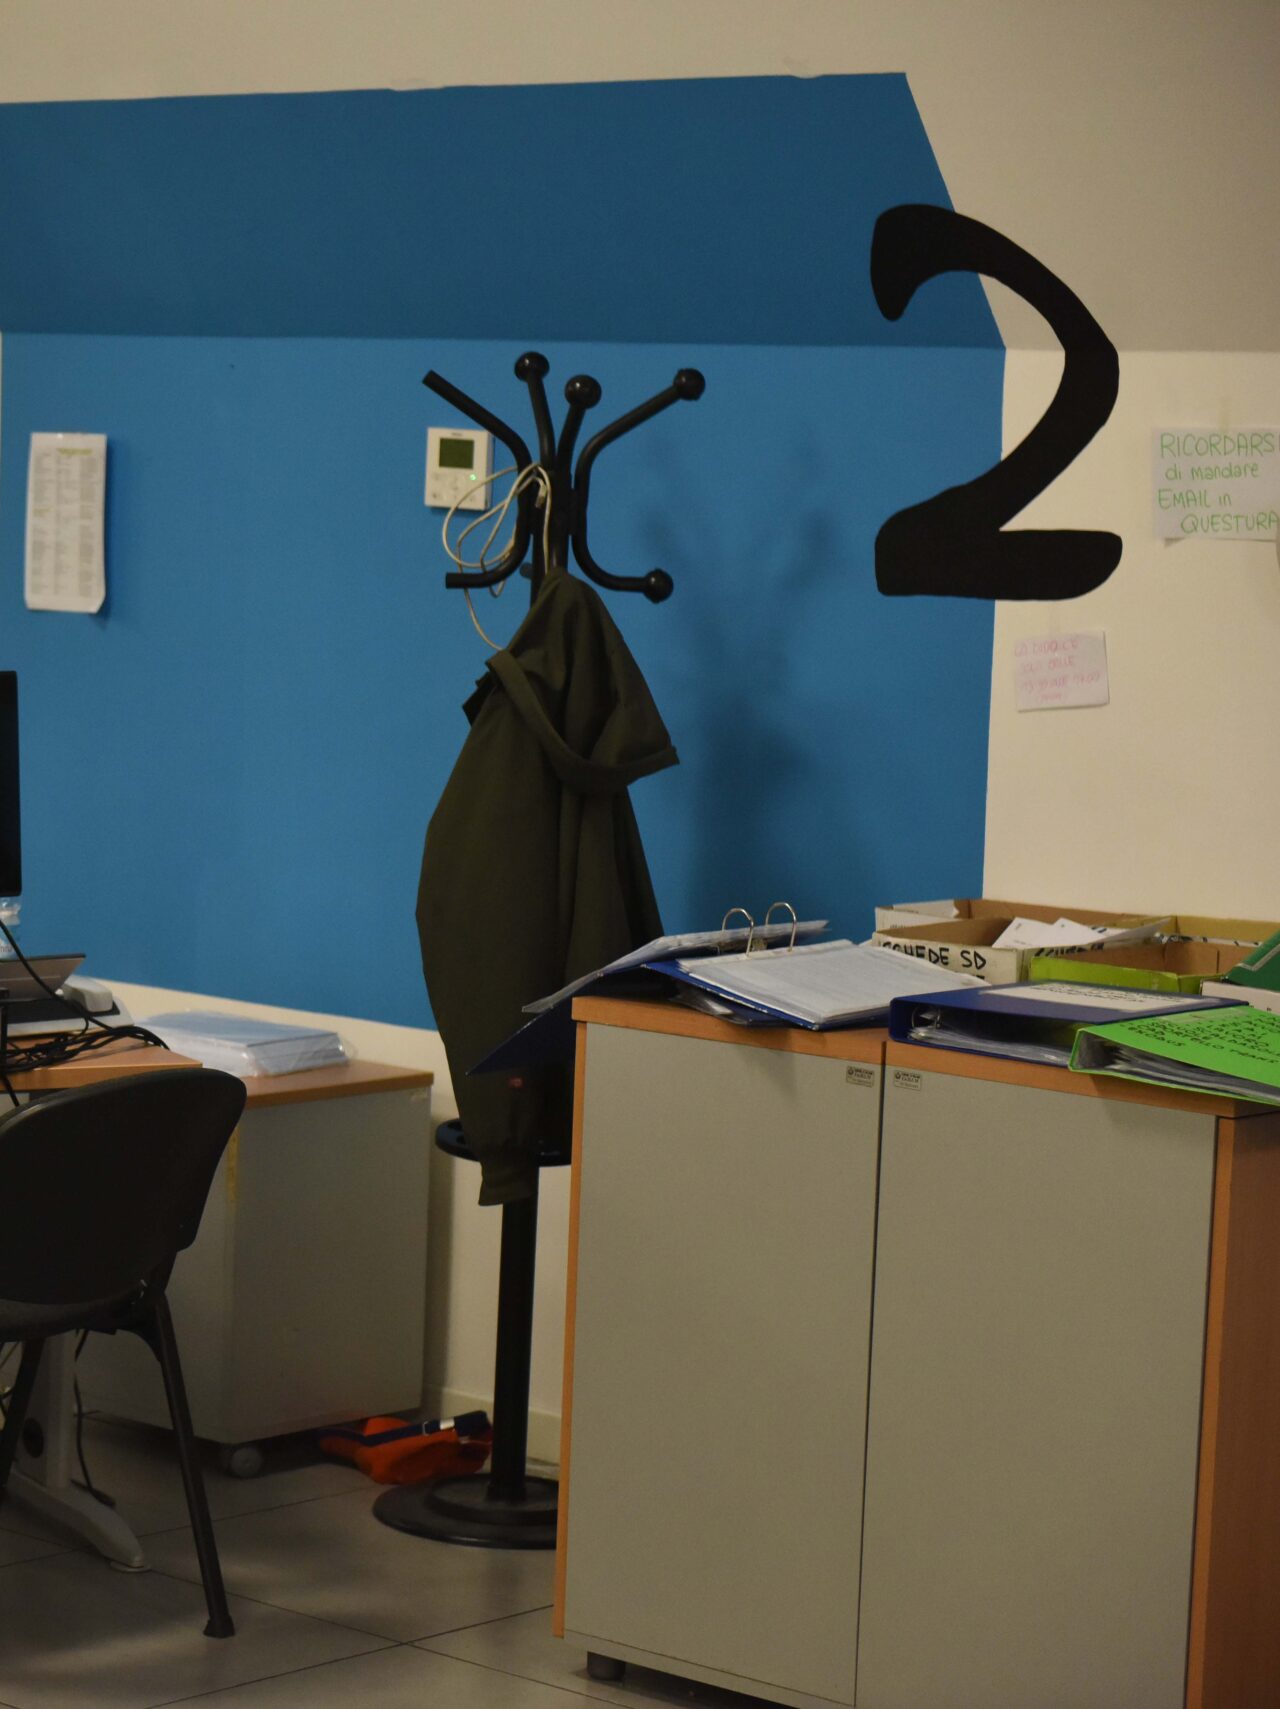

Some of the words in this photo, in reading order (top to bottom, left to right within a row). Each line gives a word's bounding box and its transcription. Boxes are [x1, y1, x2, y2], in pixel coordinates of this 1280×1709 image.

[870, 204, 1123, 600] 2
[1165, 463, 1182, 480] di
[1158, 488, 1211, 509] EMAIL
[1218, 493, 1232, 506] in
[1180, 510, 1280, 534] QUESTURA
[960, 949, 987, 970] SD
